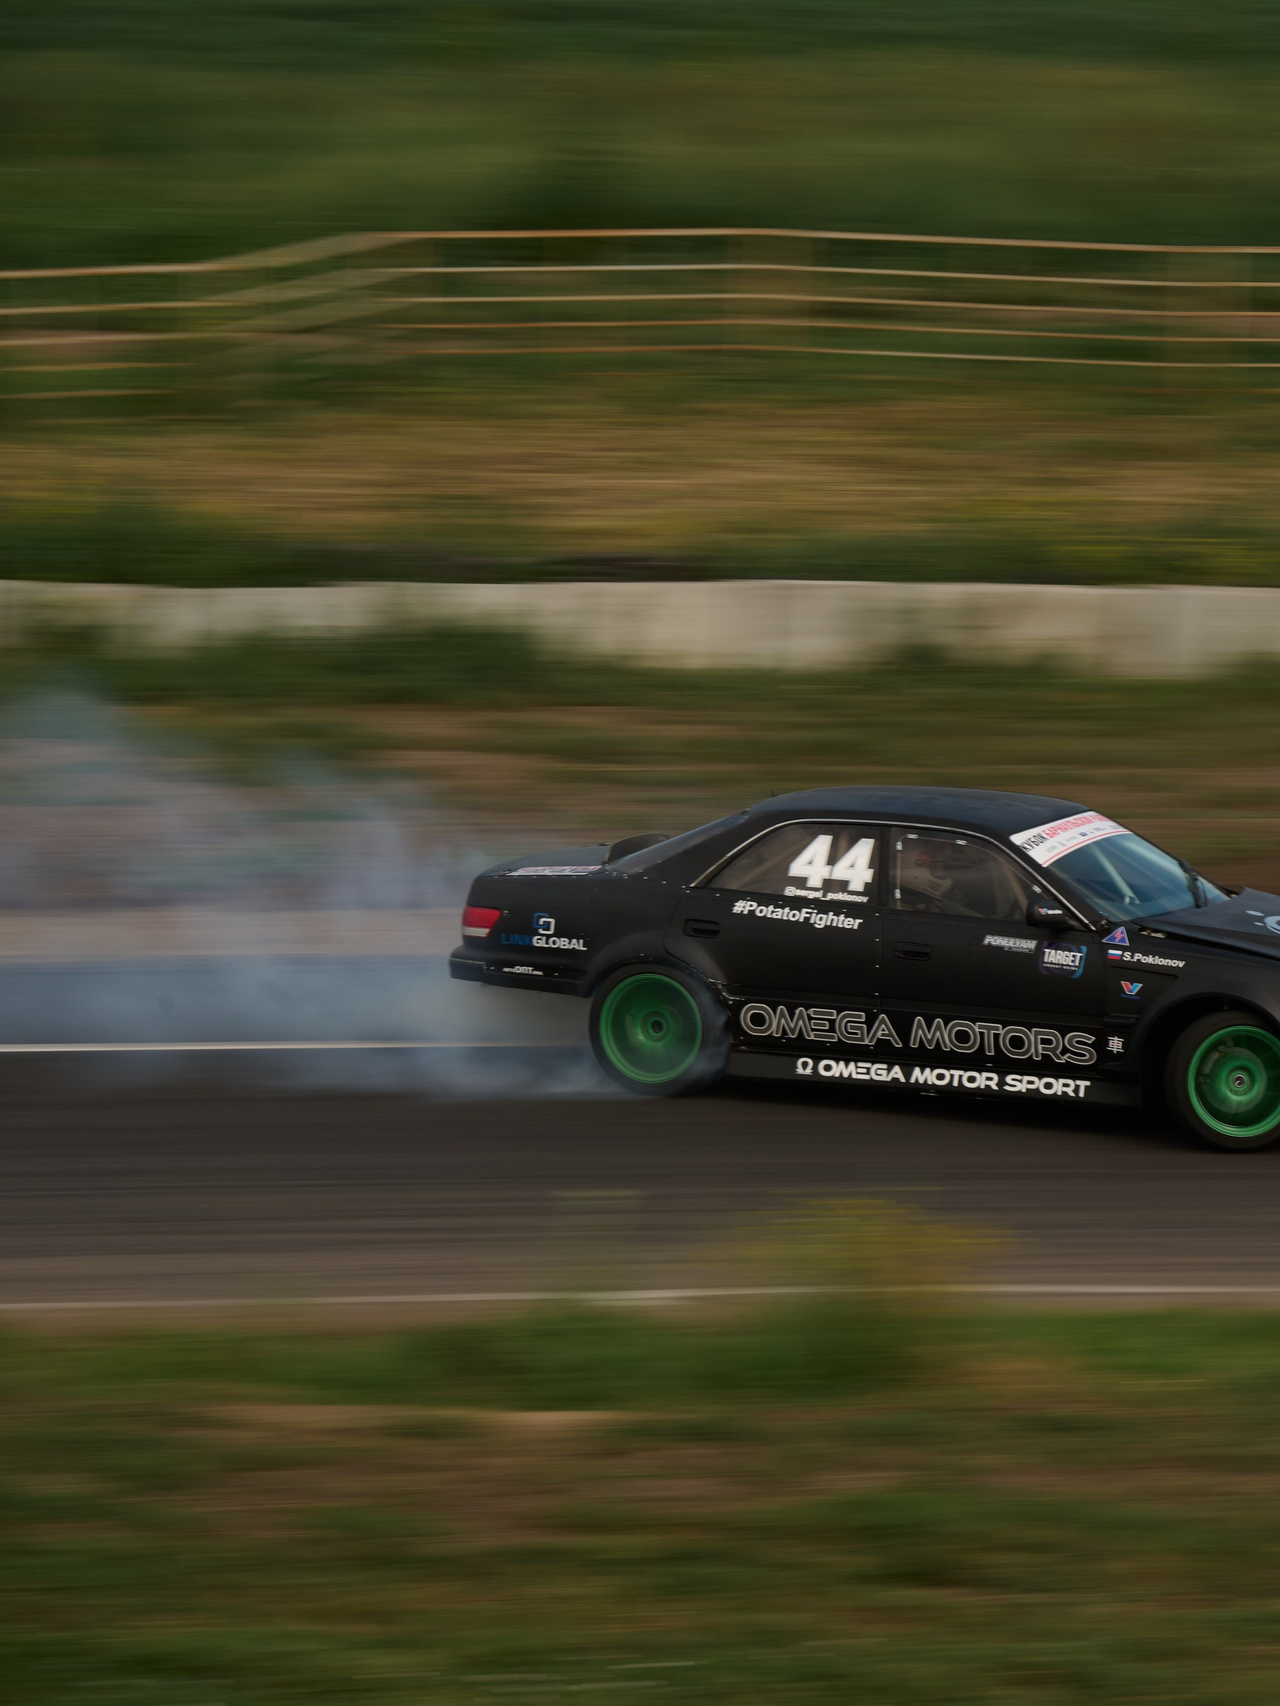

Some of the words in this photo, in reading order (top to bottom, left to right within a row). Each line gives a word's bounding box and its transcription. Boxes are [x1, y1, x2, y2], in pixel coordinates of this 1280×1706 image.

[788, 834, 876, 892] 44
[732, 899, 864, 930] #PotatoFighter
[1043, 948, 1084, 966] TARGET
[1122, 951, 1187, 968] S.Poklonov
[740, 1003, 903, 1048] OMEGA
[910, 1016, 1097, 1065] MOTORS
[1106, 1036, 1124, 1054] 車
[818, 1058, 907, 1084] OMEGA
[910, 1069, 1000, 1090] MOTOR
[1002, 1073, 1092, 1098] SPORT
